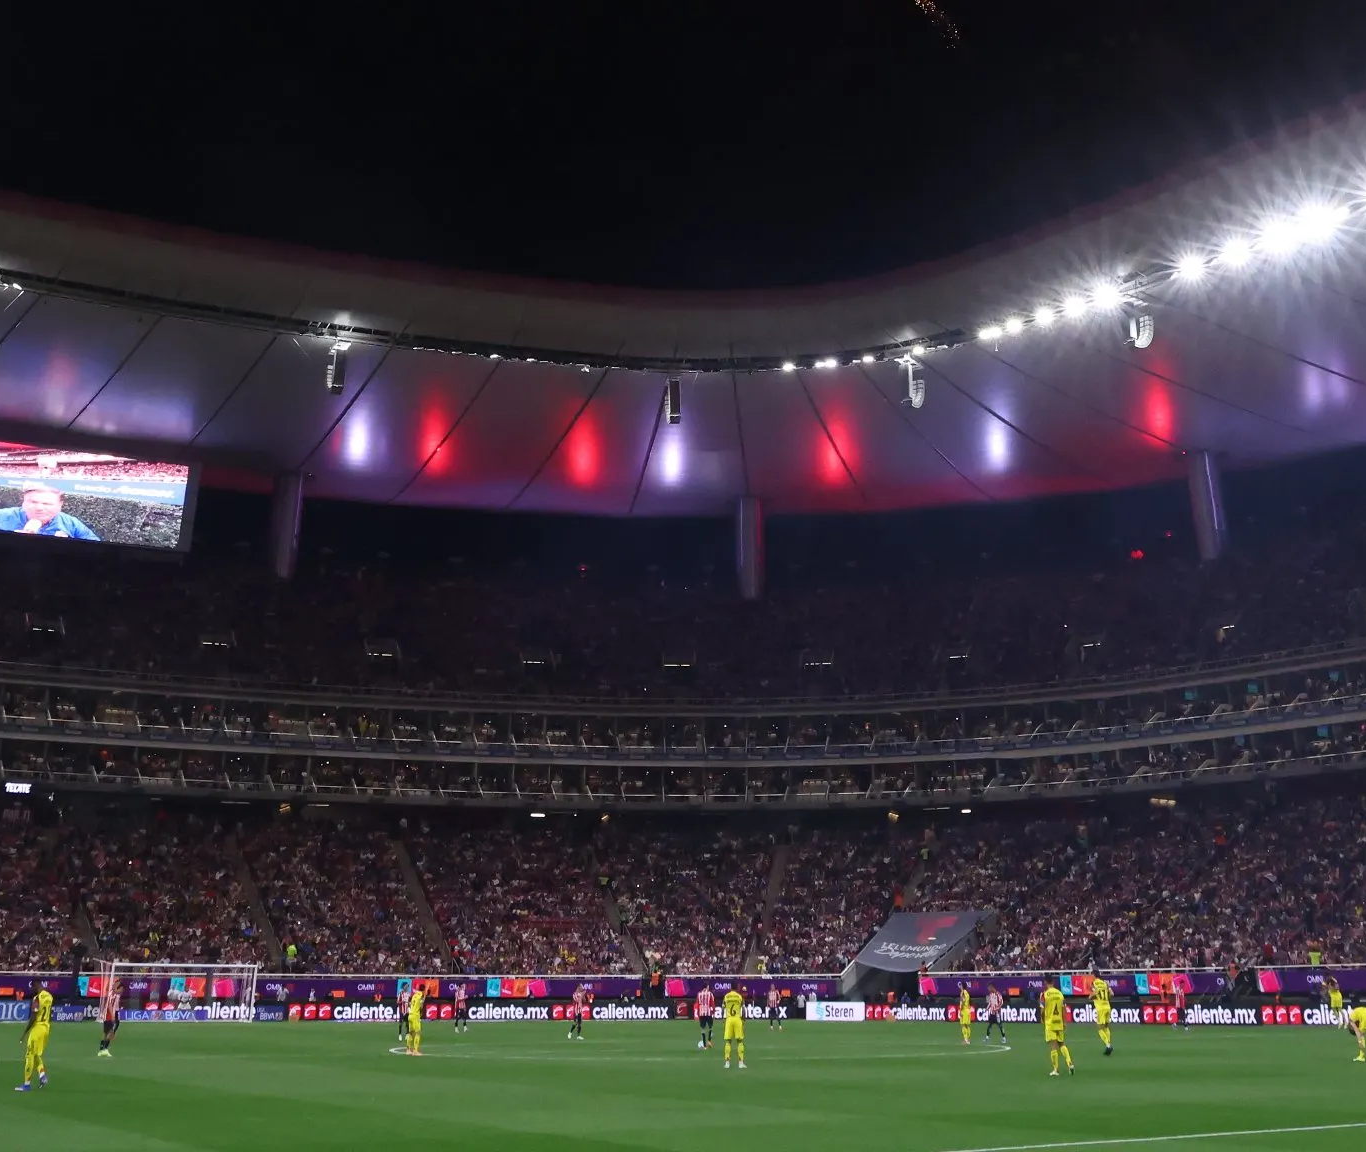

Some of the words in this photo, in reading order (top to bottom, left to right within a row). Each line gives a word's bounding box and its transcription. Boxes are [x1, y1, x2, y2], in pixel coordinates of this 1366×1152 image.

[5, 782, 32, 793] TECATE
[125, 1010, 150, 1020] LIGA
[468, 1003, 549, 1020] caliente.mx
[592, 1003, 669, 1020] caliente.mx
[824, 1004, 855, 1019] Steren
